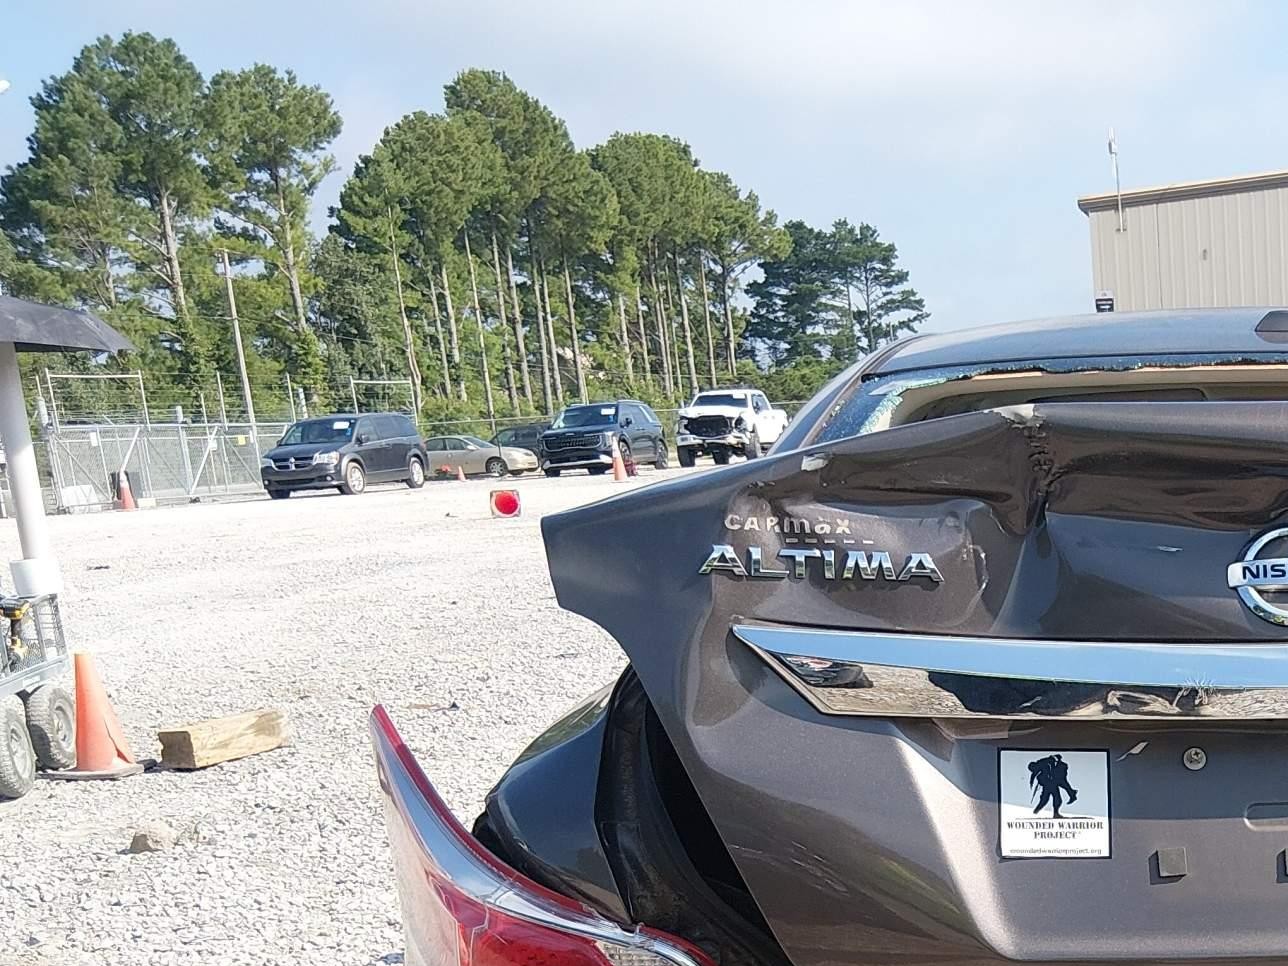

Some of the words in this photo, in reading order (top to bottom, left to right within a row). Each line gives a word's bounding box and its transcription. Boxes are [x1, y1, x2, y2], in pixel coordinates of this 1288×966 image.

[699, 544, 945, 582] ALTIMA
[1007, 821, 1054, 830] WOUNDED
[1058, 821, 1104, 830] WARRIOR
[1034, 831, 1077, 840] PROJECT
